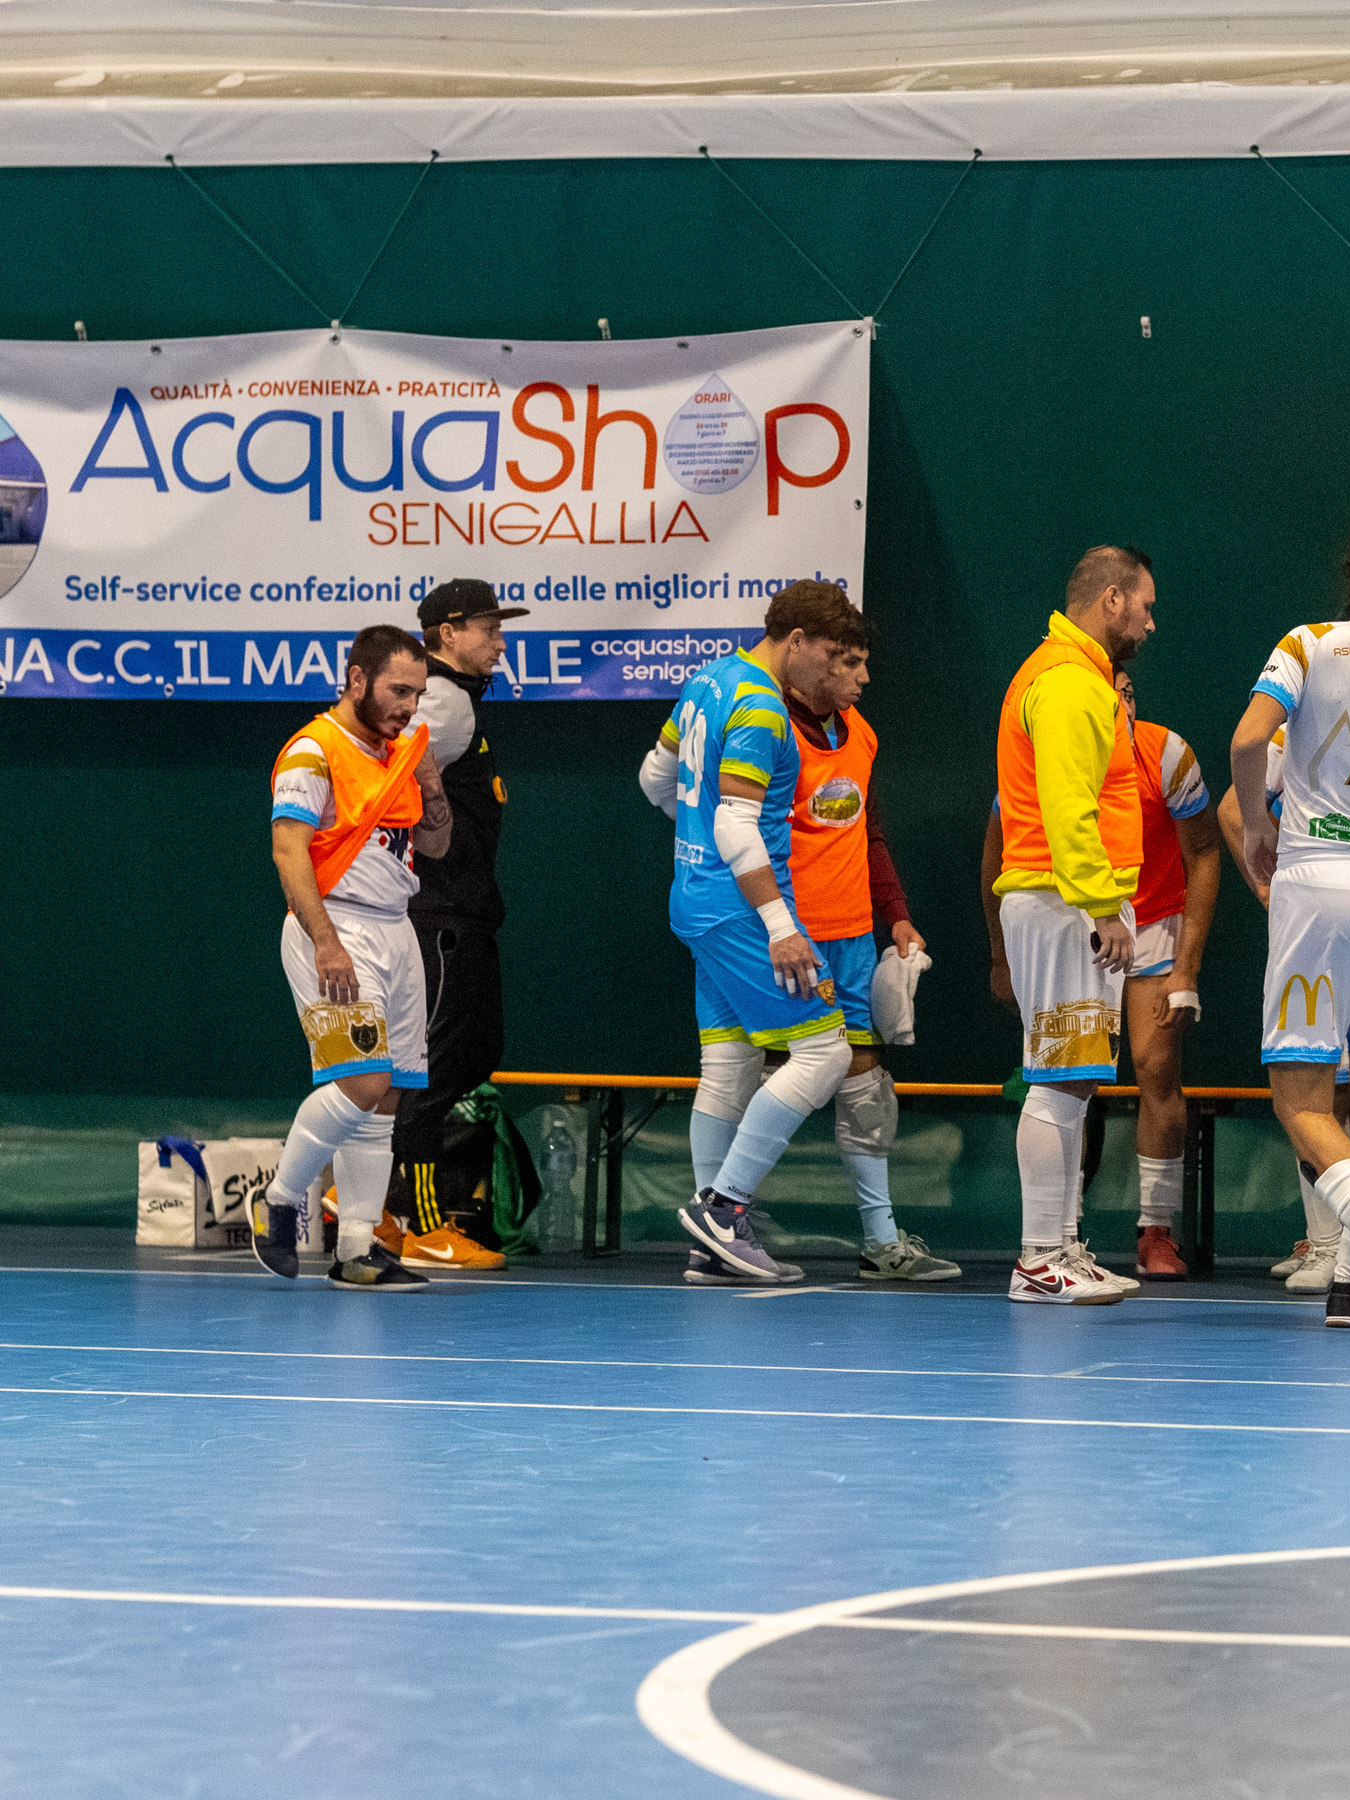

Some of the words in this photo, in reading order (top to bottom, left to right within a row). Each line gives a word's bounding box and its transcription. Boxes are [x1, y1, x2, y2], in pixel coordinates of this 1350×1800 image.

[150, 379, 233, 401] QUALITÀ
[247, 379, 381, 399] CONVENIENZA
[398, 378, 502, 399] PRATICITÀ
[694, 392, 732, 404] ORARI
[368, 500, 711, 548] SENIGALLIA
[65, 575, 242, 603] Self-service
[250, 575, 402, 603] confezioni
[409, 576, 526, 603] d'ua
[534, 575, 607, 603] delle
[616, 573, 729, 610] migliori
[738, 571, 849, 599] marhe
[591, 634, 733, 663] acquashop
